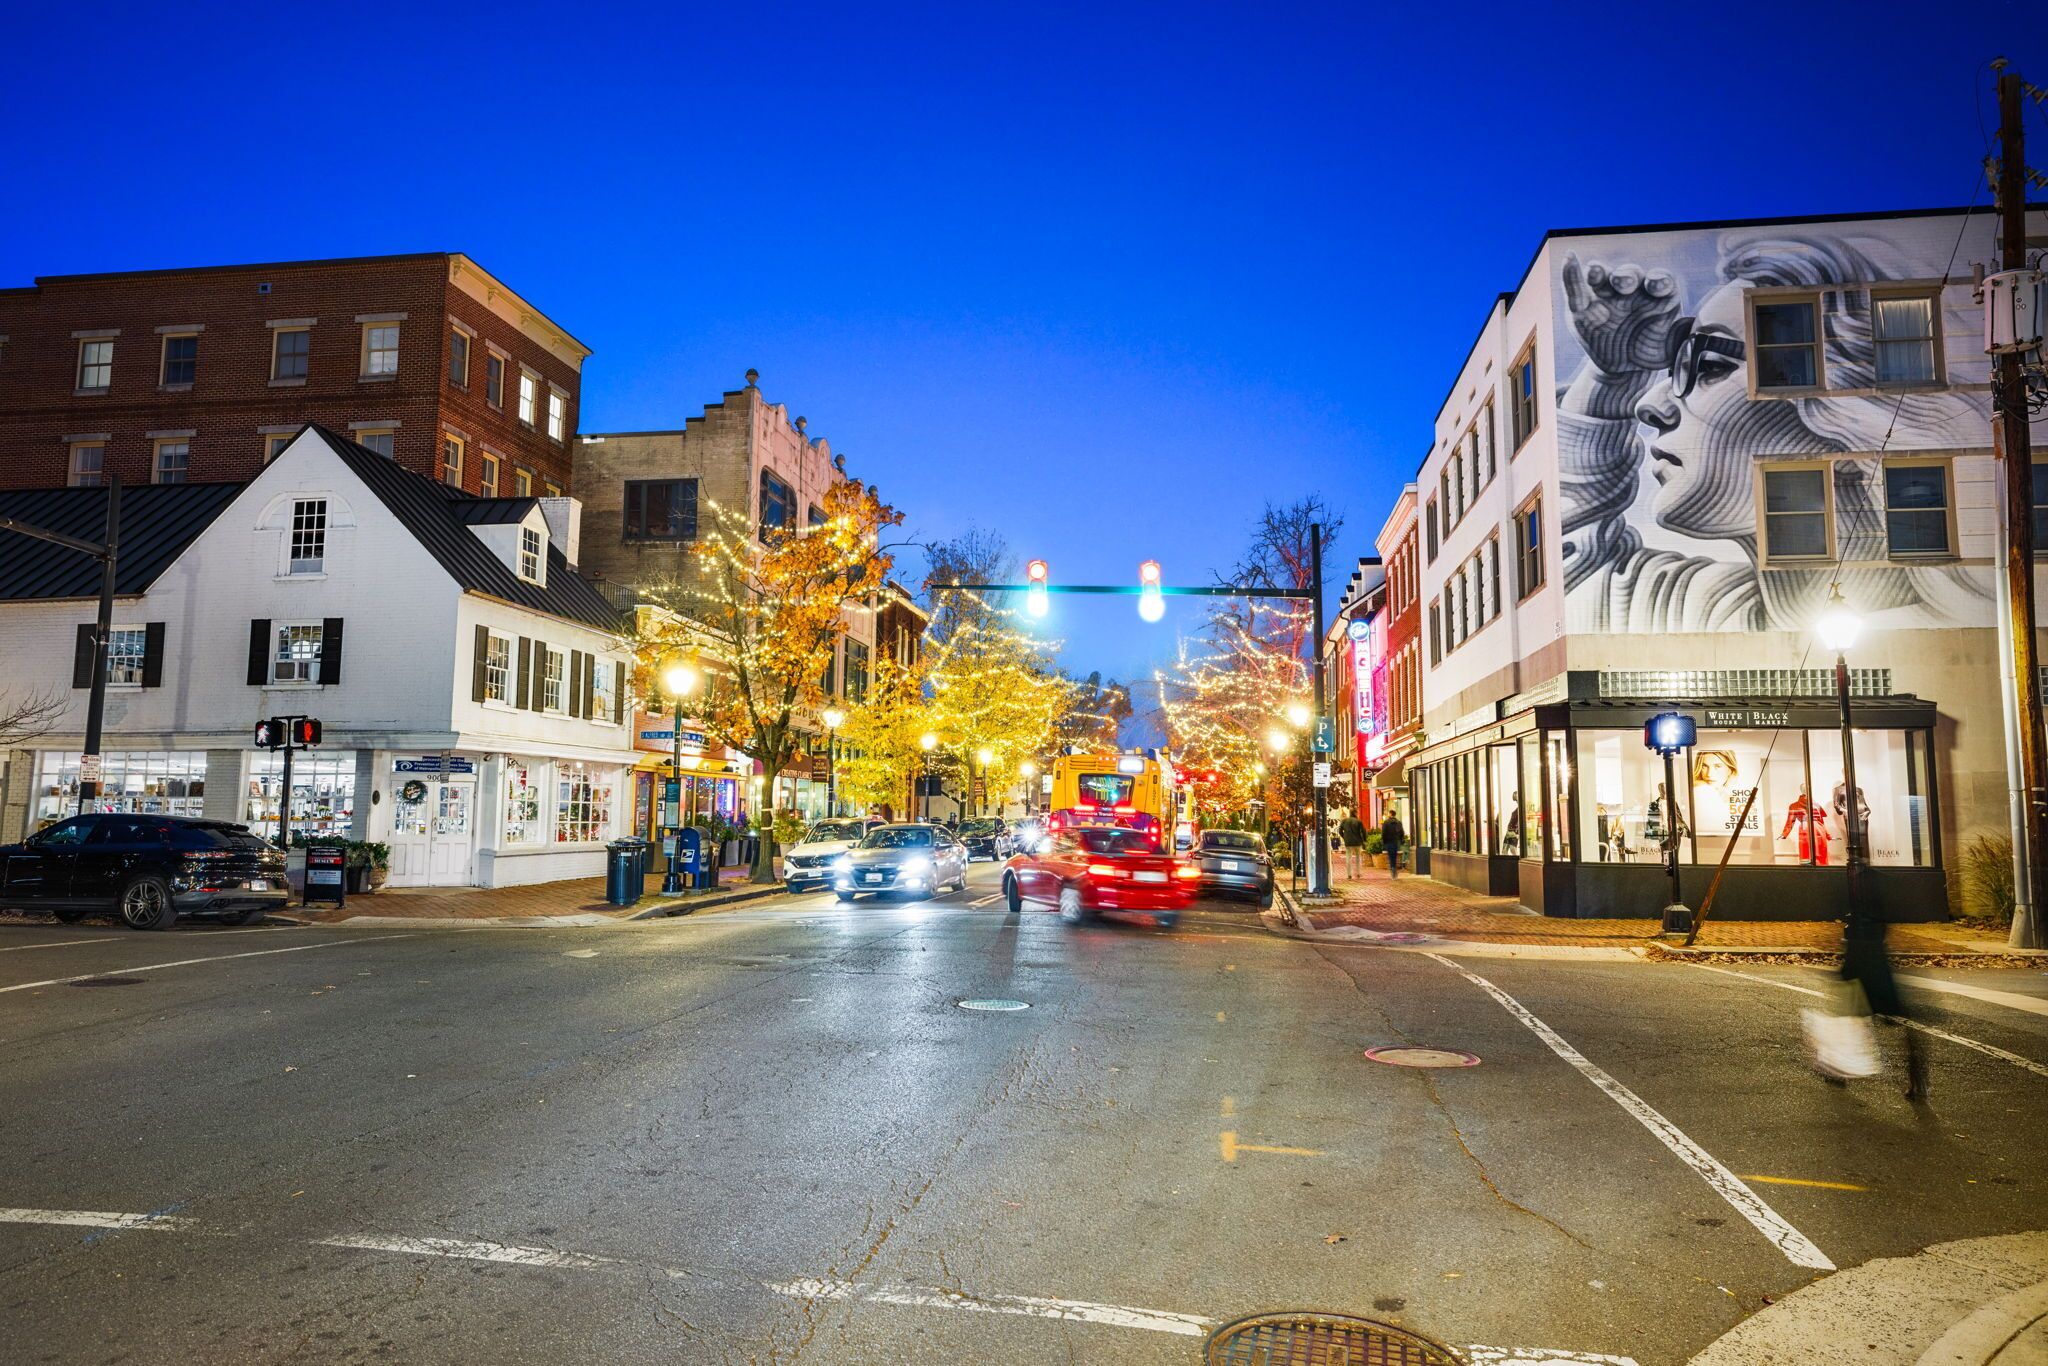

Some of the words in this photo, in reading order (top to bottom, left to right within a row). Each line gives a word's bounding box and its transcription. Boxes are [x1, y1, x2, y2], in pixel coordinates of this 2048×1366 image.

[1709, 712, 1743, 720] WHITE
[1753, 712, 1789, 720] BLACK
[1318, 722, 1328, 735] P
[1732, 789, 1753, 797] SHO
